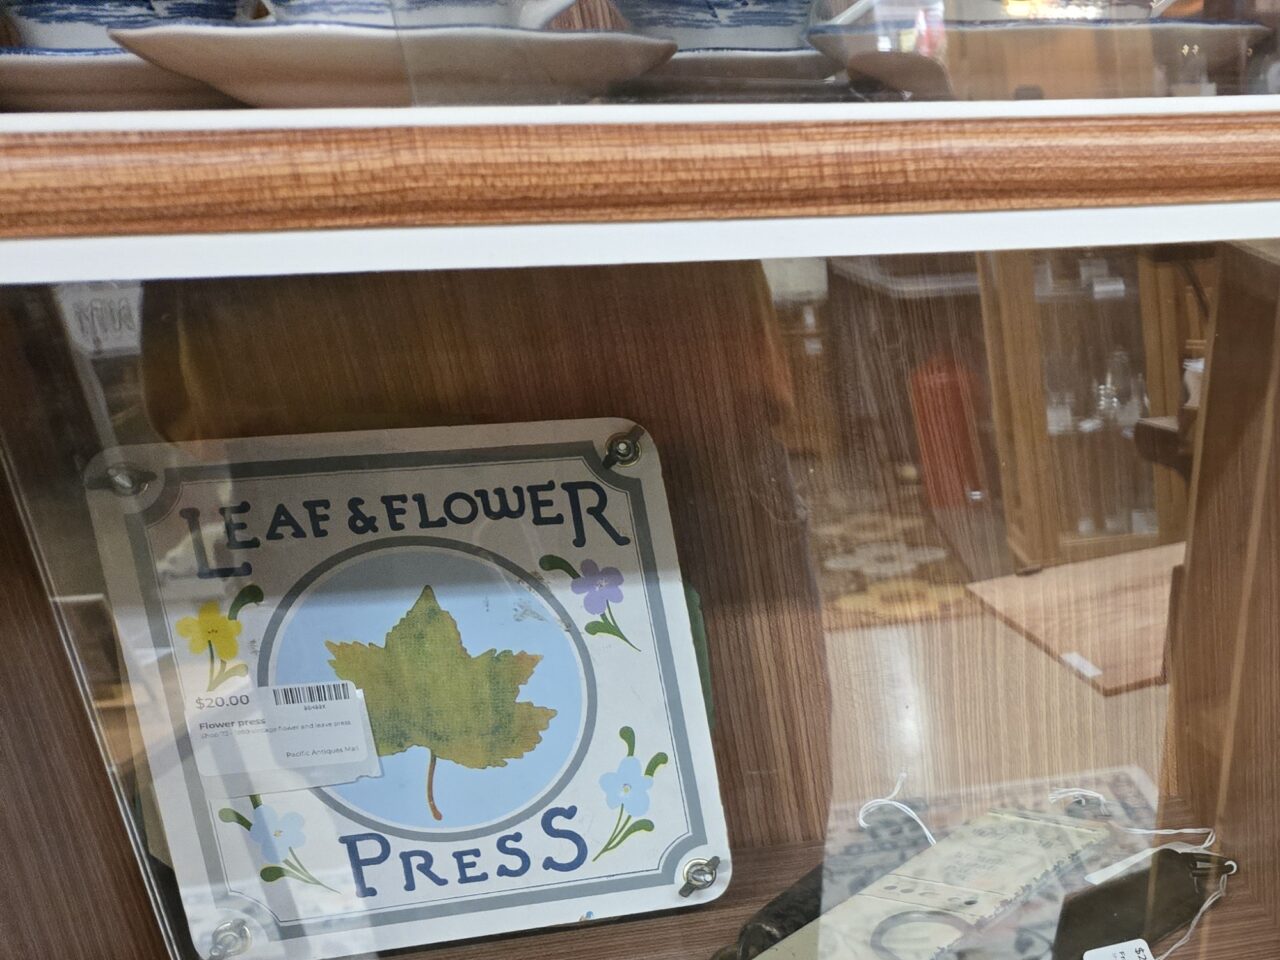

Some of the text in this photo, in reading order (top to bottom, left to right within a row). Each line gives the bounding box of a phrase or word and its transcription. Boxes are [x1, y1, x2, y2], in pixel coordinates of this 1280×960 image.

[179, 479, 630, 580] LEAF & FLOWER
[195, 694, 250, 710] $20.00
[199, 717, 267, 731] Flower press
[339, 804, 589, 898] PRESS
